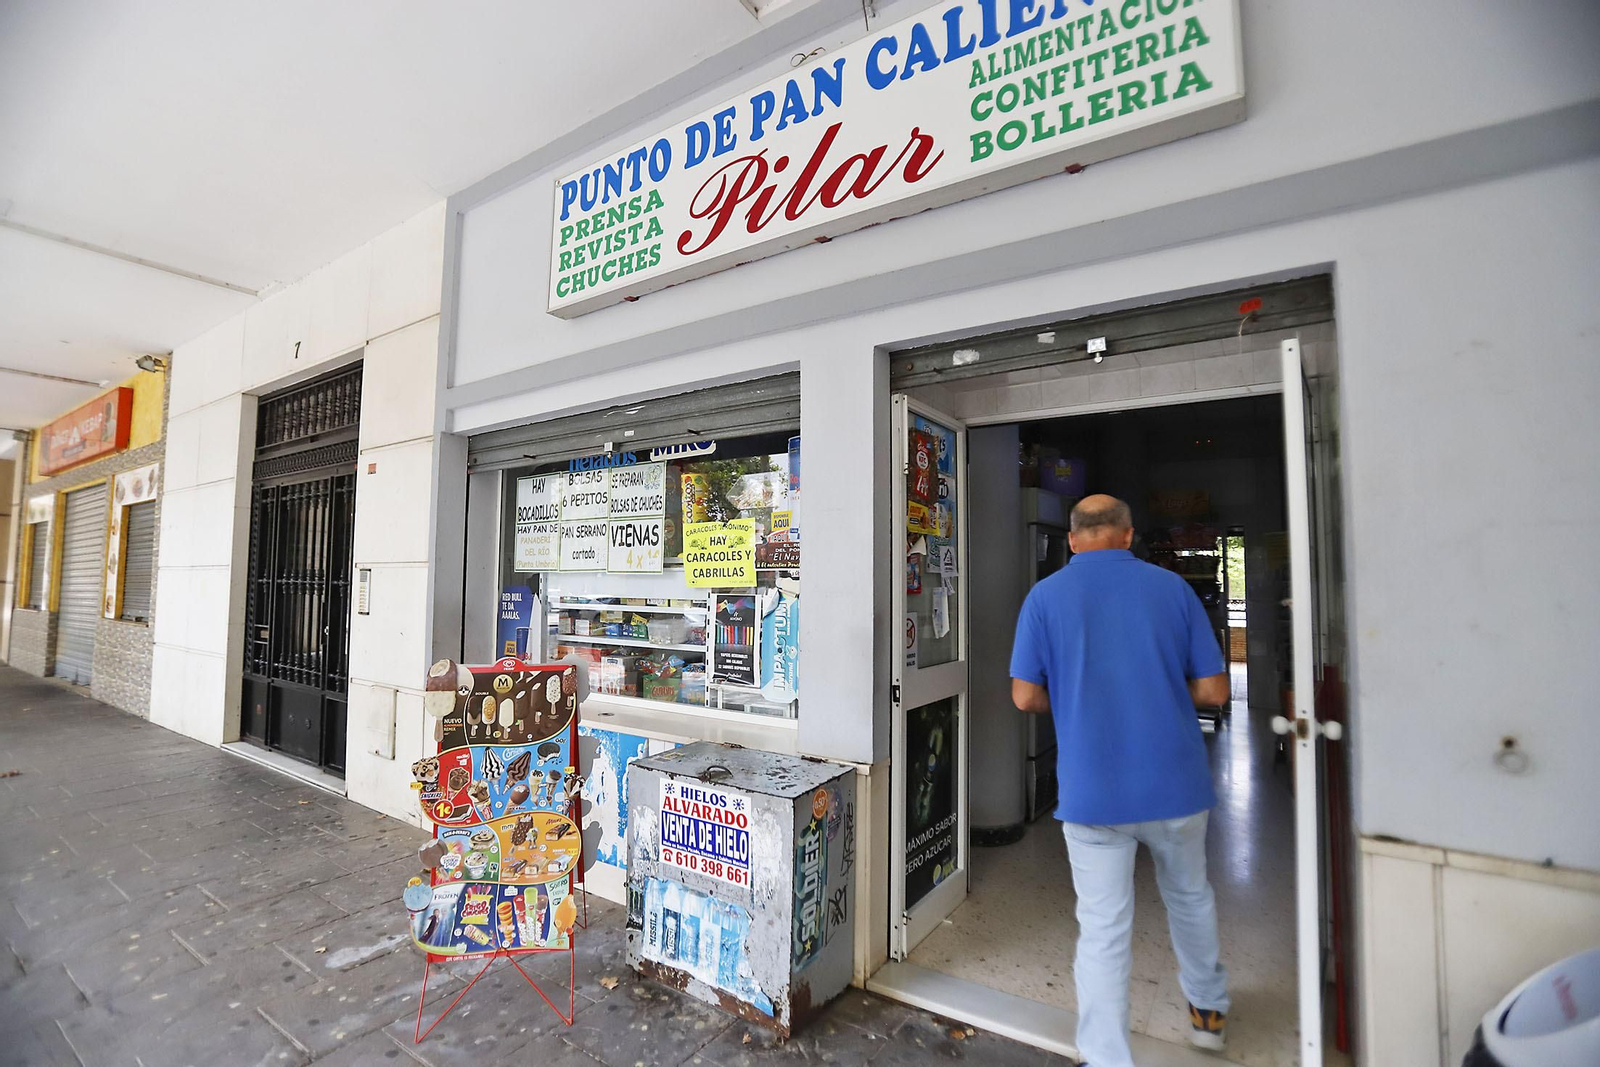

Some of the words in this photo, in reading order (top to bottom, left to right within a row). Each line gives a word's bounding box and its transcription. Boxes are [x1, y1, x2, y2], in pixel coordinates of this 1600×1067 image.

[968, 0, 1203, 90] ALIMENTACIO
[970, 17, 1210, 122] CONFITERIA
[970, 61, 1213, 163] BOLLERIA
[559, 138, 672, 221] PUNTO
[684, 105, 737, 170] DE
[749, 57, 846, 142] PAN
[676, 121, 944, 255] Pilar
[559, 189, 664, 248] PRENSA
[558, 216, 664, 273] REVISTA
[556, 243, 662, 298] CHUCHES
[294, 341, 302, 360] 7
[532, 478, 546, 494] HAY
[568, 471, 603, 486] BOLSAS
[611, 474, 619, 489] SE
[619, 471, 644, 488] PREPARAN
[562, 495, 568, 507] 6
[570, 492, 608, 507] PEPITOS
[611, 497, 630, 513] BOLSAS
[631, 496, 638, 512] DE
[639, 495, 663, 511] CHUCHES
[518, 504, 559, 522] BOCADILLOS
[517, 525, 532, 534] HAY
[533, 524, 547, 534] PAN
[549, 523, 558, 533] DE
[561, 526, 574, 539] PAN
[576, 523, 607, 539] SERRANO
[611, 523, 660, 548] VIENAS
[710, 535, 727, 547] HAY
[572, 547, 596, 560] cortado
[686, 550, 742, 563] CARACOLES
[744, 550, 752, 561] Y
[692, 566, 745, 579] CABRILLAS
[502, 593, 511, 602] RED
[511, 593, 522, 602] BULL
[502, 602, 508, 611] TE
[508, 602, 515, 611] DA
[498, 678, 509, 688] M
[680, 786, 727, 808] HIELOS
[662, 795, 748, 829] ALVARADO
[935, 812, 957, 836] SABOR
[662, 812, 695, 845] VENTA
[697, 820, 713, 849] DE
[715, 824, 749, 863] HIELO
[676, 851, 697, 871] 610
[701, 858, 724, 878] 398
[726, 864, 749, 886] 661
[801, 834, 821, 942] SOLDIER
